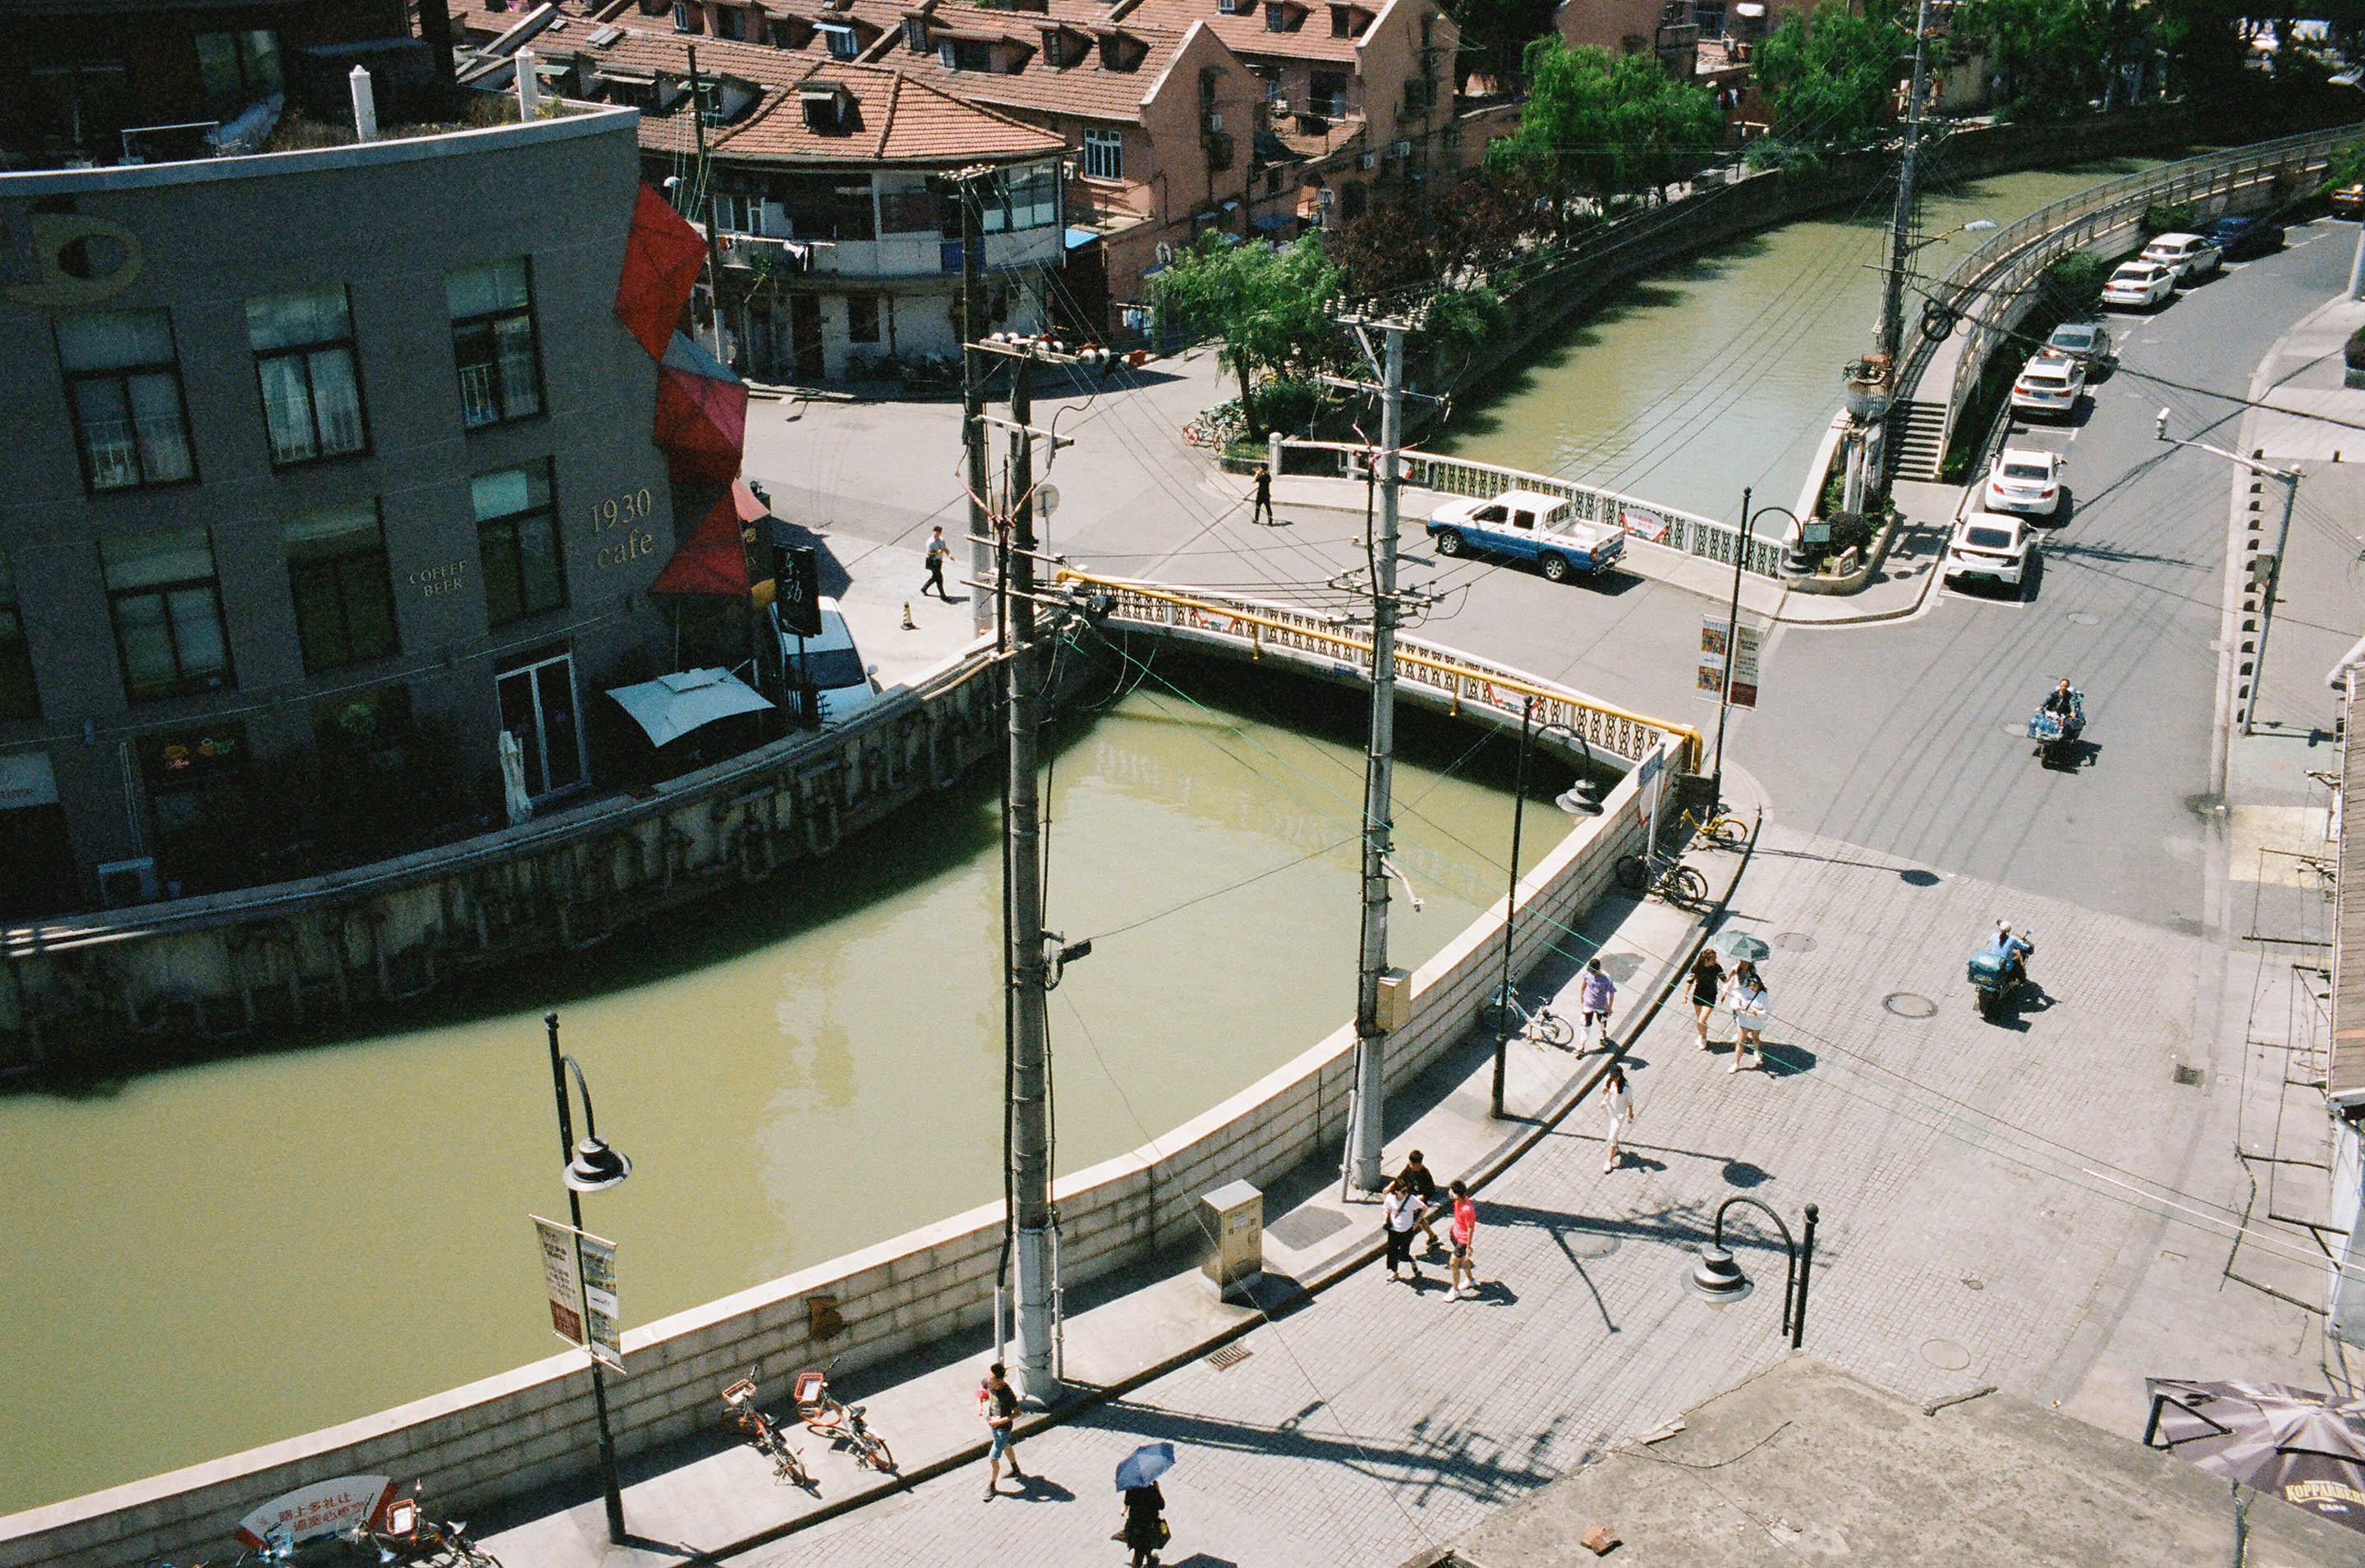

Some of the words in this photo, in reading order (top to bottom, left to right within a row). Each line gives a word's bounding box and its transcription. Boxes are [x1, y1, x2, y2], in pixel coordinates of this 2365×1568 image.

[591, 488, 651, 533] 1930
[597, 529, 653, 570] cafe
[409, 560, 467, 585] COFFEE
[423, 577, 463, 597] BEER
